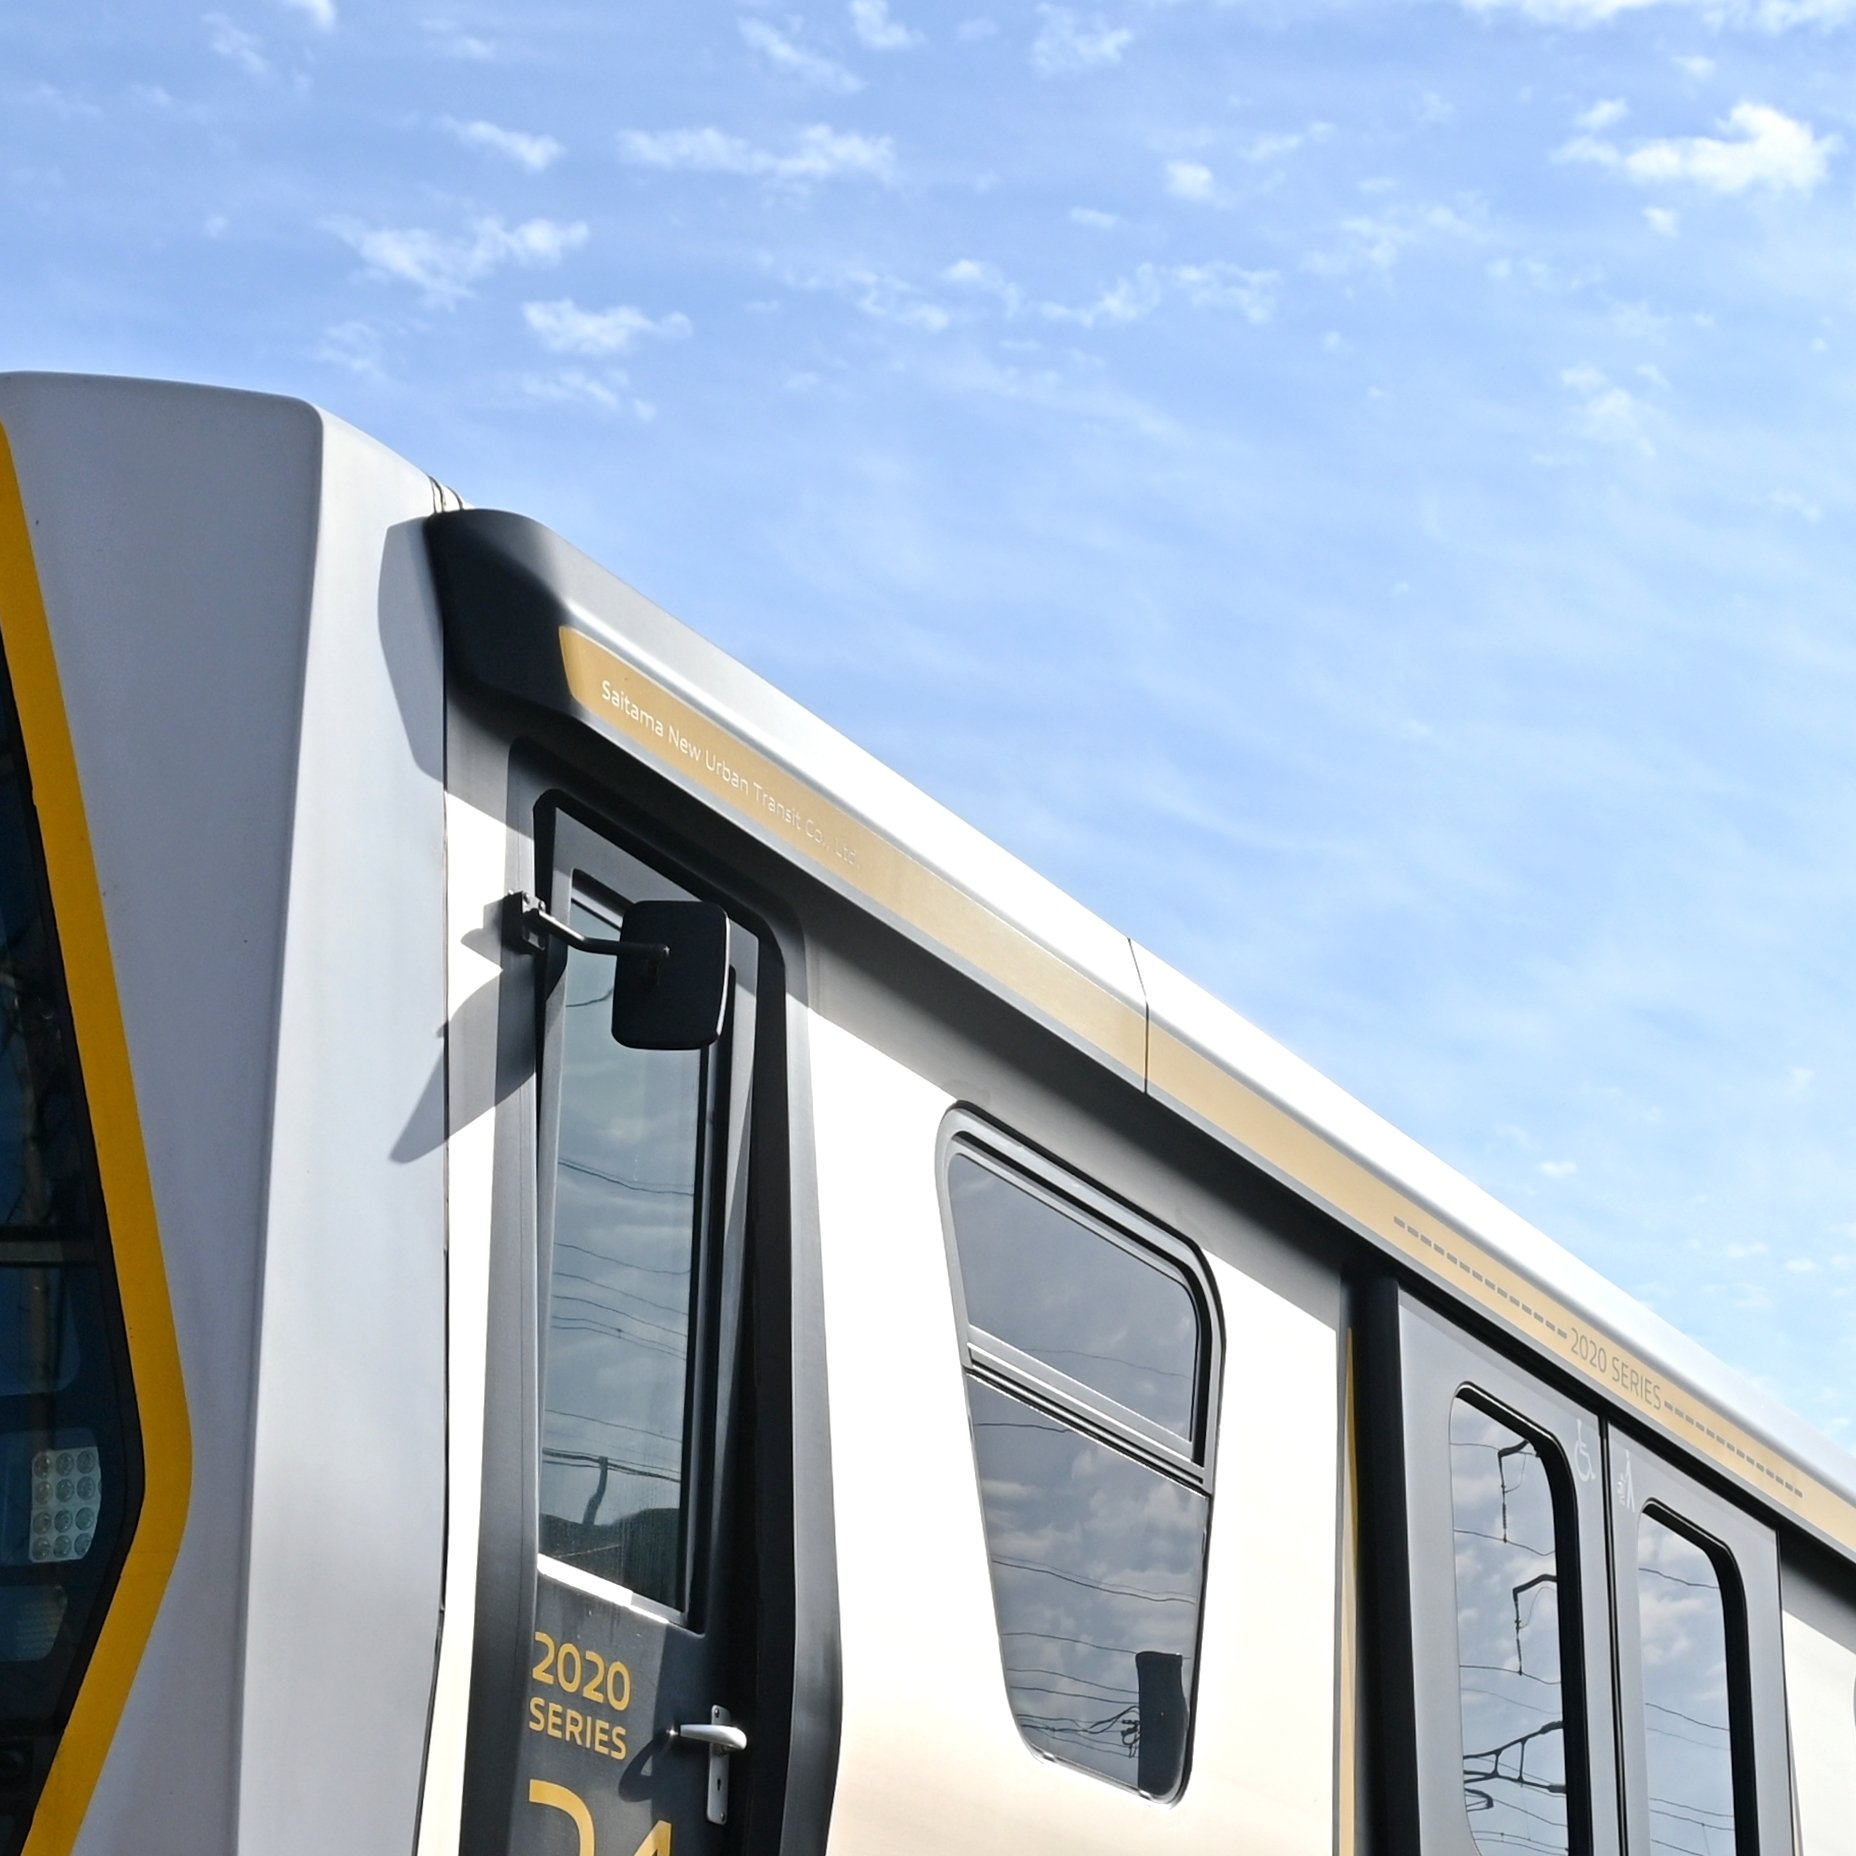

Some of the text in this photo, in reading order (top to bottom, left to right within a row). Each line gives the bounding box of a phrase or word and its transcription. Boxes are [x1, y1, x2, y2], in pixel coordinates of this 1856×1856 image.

[601, 680, 664, 737] Saitama
[668, 725, 702, 762] New
[705, 750, 749, 795] Urban
[752, 781, 802, 831] Transit
[1570, 1327, 1662, 1410] 2020 SERIES
[531, 1631, 632, 1712] 2020
[528, 1696, 628, 1761] SERIES
